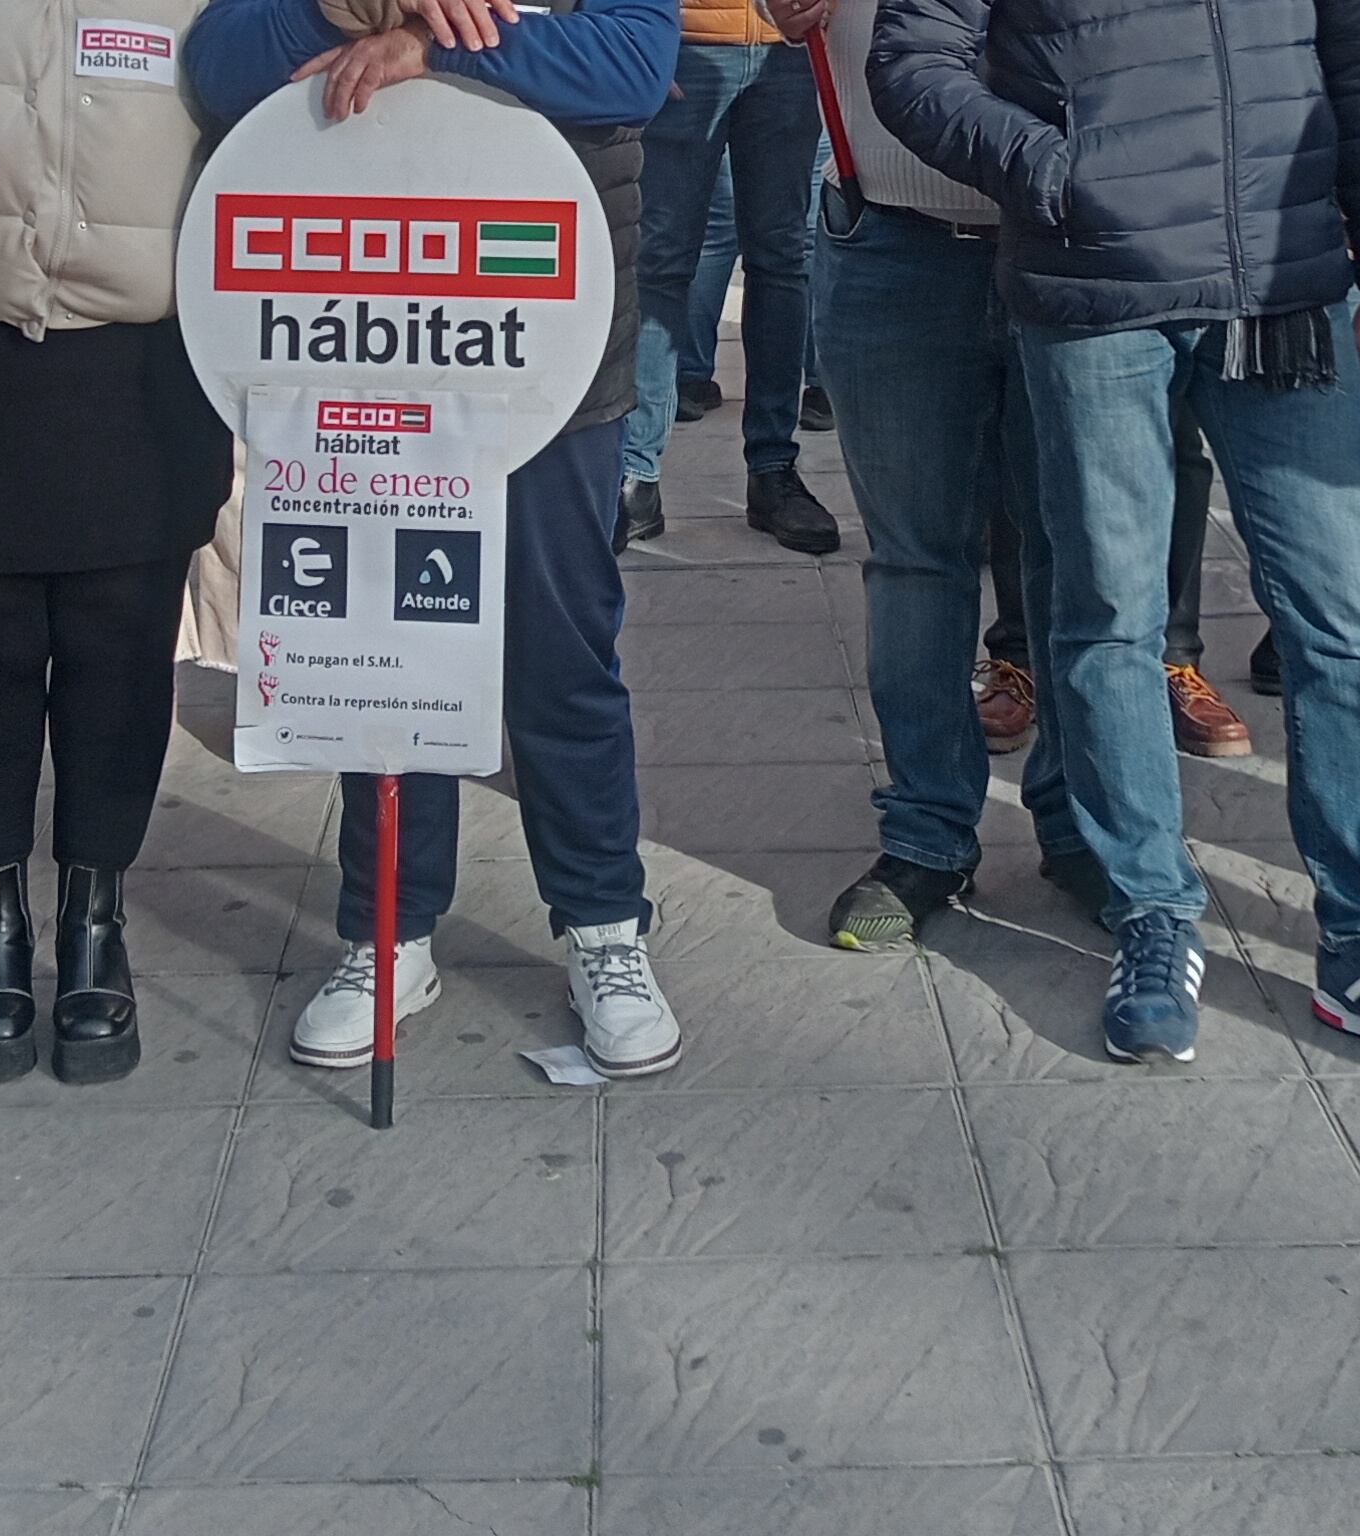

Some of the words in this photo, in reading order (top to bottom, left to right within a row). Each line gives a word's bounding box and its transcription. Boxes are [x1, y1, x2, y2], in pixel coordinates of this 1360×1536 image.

[85, 32, 145, 50] CCOO
[80, 51, 149, 71] hábitat
[232, 216, 460, 274] CCOO
[260, 298, 526, 368] hábitat
[323, 406, 396, 427] CCOO
[315, 432, 400, 455] hábitat
[264, 459, 306, 493] 20
[318, 457, 358, 494] de
[370, 471, 470, 499] enero
[271, 496, 400, 517] Concentración
[407, 502, 473, 519] contra:
[268, 595, 332, 617] Clece
[401, 592, 470, 612] Atende
[286, 652, 305, 665] No
[308, 654, 349, 669] pagan
[353, 654, 365, 667] el
[367, 656, 403, 669] S.M.I.
[281, 693, 325, 707] Contra
[329, 693, 341, 707] la
[344, 696, 409, 712] represión
[411, 698, 463, 713] sindical
